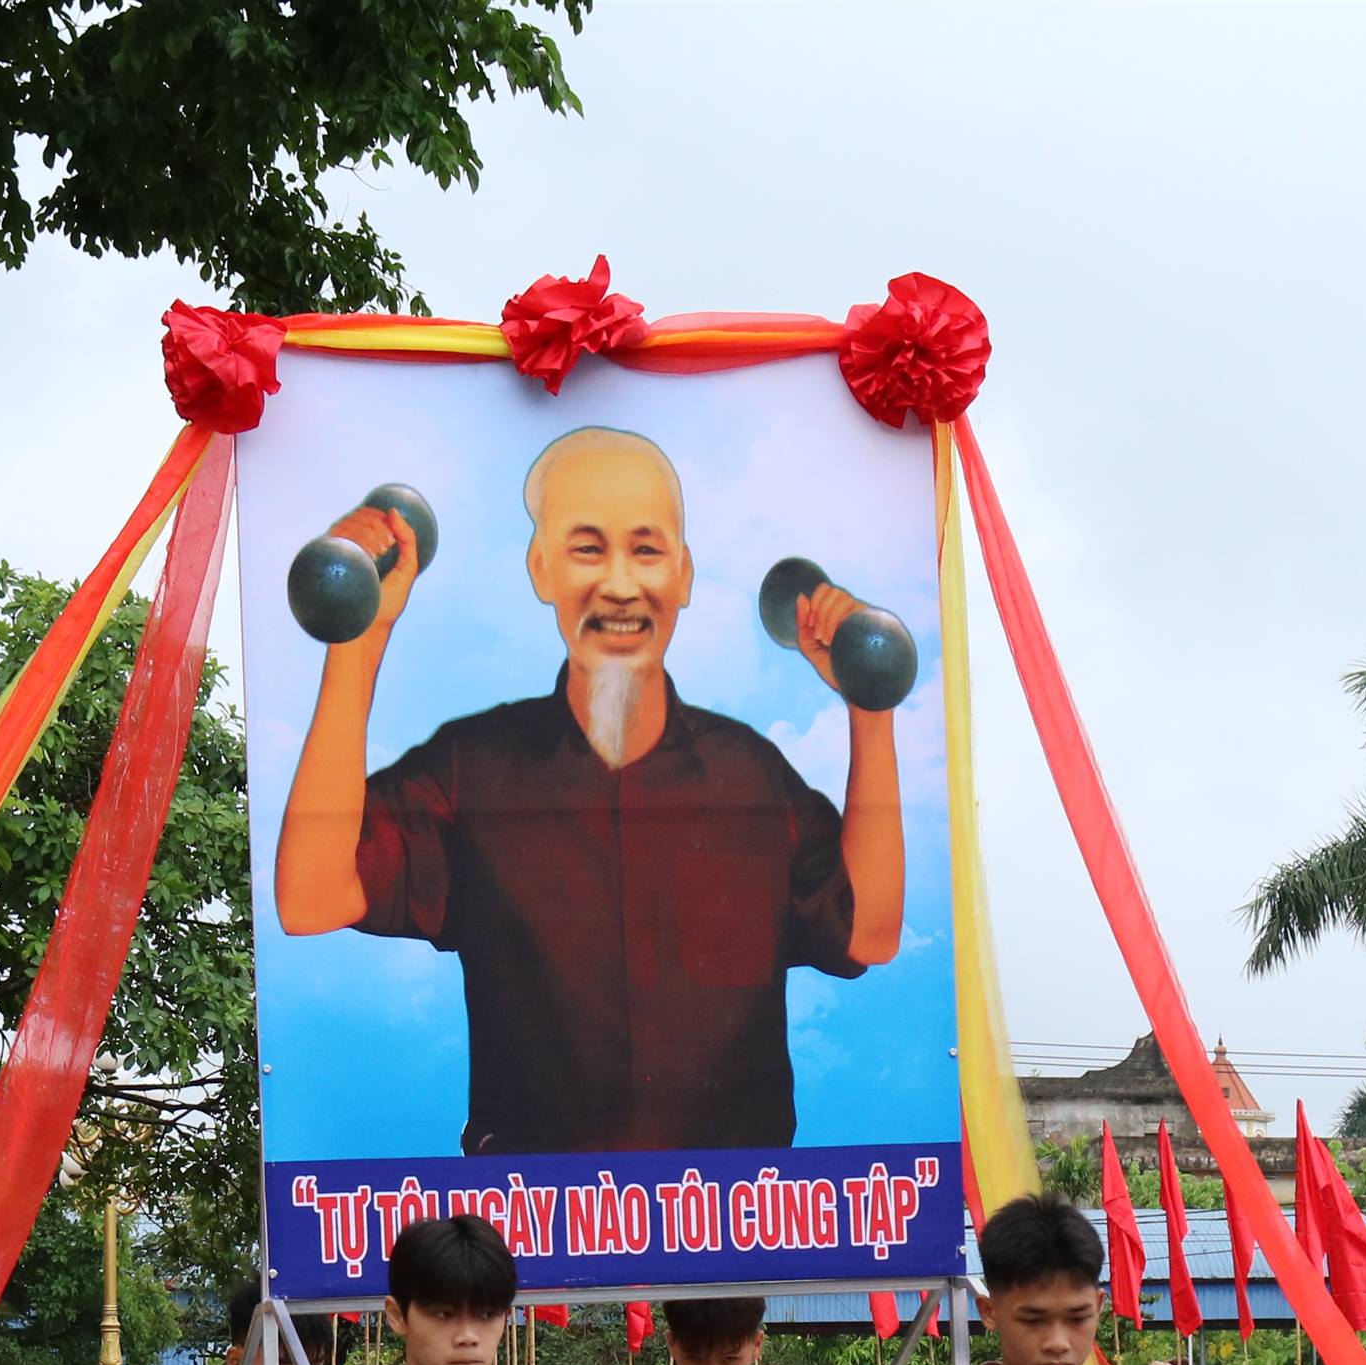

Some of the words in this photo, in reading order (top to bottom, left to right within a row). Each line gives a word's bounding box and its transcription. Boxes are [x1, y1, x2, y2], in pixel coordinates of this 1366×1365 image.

[292, 1175, 371, 1278] “TỰ
[565, 1170, 651, 1256] NÀO
[657, 1167, 722, 1253] TÔI
[729, 1166, 838, 1252] CŨNG
[843, 1156, 939, 1260] TẬP”
